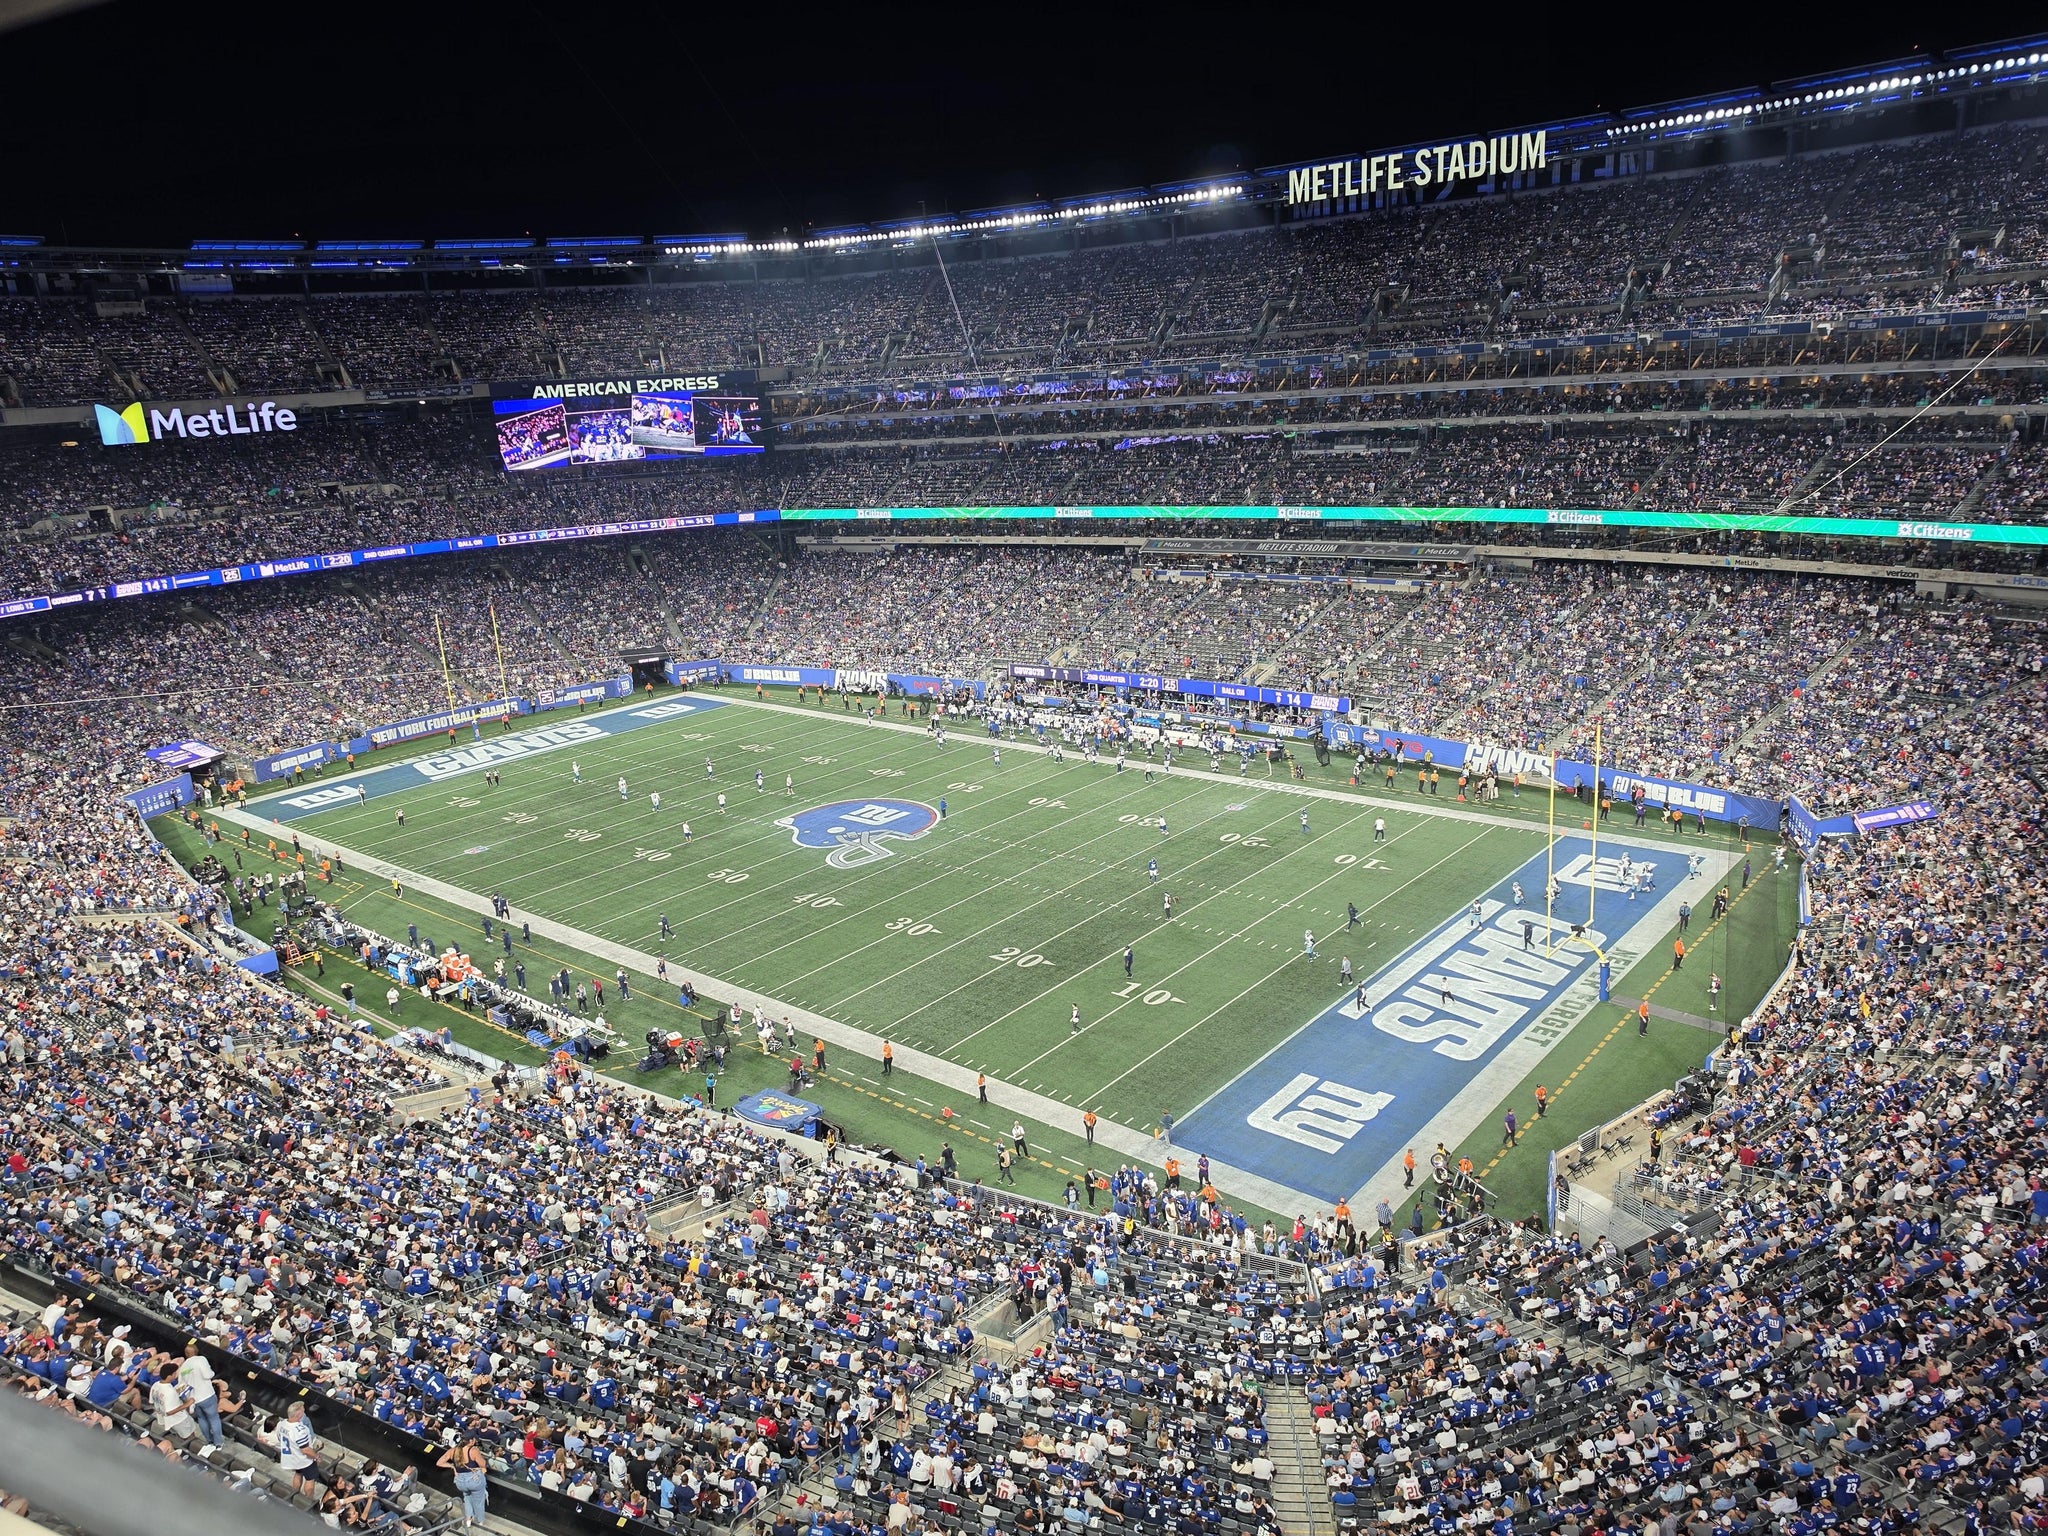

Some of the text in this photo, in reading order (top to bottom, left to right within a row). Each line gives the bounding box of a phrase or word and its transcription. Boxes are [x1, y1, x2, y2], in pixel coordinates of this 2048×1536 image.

[1288, 153, 1404, 205] METLIFE
[1414, 130, 1547, 188] STADIUM
[532, 376, 719, 399] AMERICAN EXPRESS
[150, 402, 298, 440] MetLife
[864, 510, 890, 518] Citizens
[1061, 508, 1092, 517] Citizens
[1286, 508, 1321, 518] Citizens
[1559, 511, 1603, 524] Citizens
[1912, 524, 1971, 539] Citizens
[1163, 541, 1192, 549] MetLife
[1256, 543, 1339, 552] METLIFE STADIUM
[377, 548, 406, 557] QUARTER
[1424, 548, 1459, 556] MetLife
[329, 555, 350, 565] 2:20
[1734, 558, 1759, 568] MetLife
[274, 561, 309, 572] MetLife
[225, 570, 238, 580] 25
[1886, 570, 1919, 579] verizon
[145, 581, 160, 592] 14
[85, 590, 94, 602] 7
[1050, 670, 1056, 679] 7
[1099, 675, 1126, 684] QUARTER
[1139, 677, 1158, 687] 2:20
[1165, 679, 1176, 689] 25
[1221, 686, 1245, 696] BALL ON
[541, 694, 552, 703] 25
[1287, 694, 1339, 709] 14 GIANTS
[372, 727, 398, 744] NEW
[399, 720, 427, 739] YORK
[427, 709, 476, 731] FOOTBALL
[414, 722, 606, 777] GIANTS
[1464, 743, 1552, 777] GIANTS
[1613, 776, 1630, 793] GO
[1668, 787, 1725, 813] BLUE
[1027, 796, 1062, 809] 40
[1219, 833, 1260, 847] 20
[1333, 854, 1381, 869] 10
[707, 868, 750, 884] 50
[792, 892, 836, 909] 40
[885, 917, 934, 936] 30
[989, 947, 1046, 968] 20
[1371, 908, 1608, 1062] GIANTS
[1111, 982, 1173, 1006] 10
[584, 1280, 590, 1290] 5
[1263, 1332, 1272, 1341] 82
[1392, 1348, 1397, 1356] 1
[1367, 1369, 1376, 1381] 13
[431, 1382, 441, 1392] 1
[601, 1388, 607, 1396] 9
[1589, 1381, 1598, 1392] 13
[373, 1406, 379, 1416] 5
[1079, 1416, 1083, 1425] 1
[975, 1476, 983, 1486] 4
[738, 1490, 743, 1502] 1
[1407, 1485, 1419, 1499] 21
